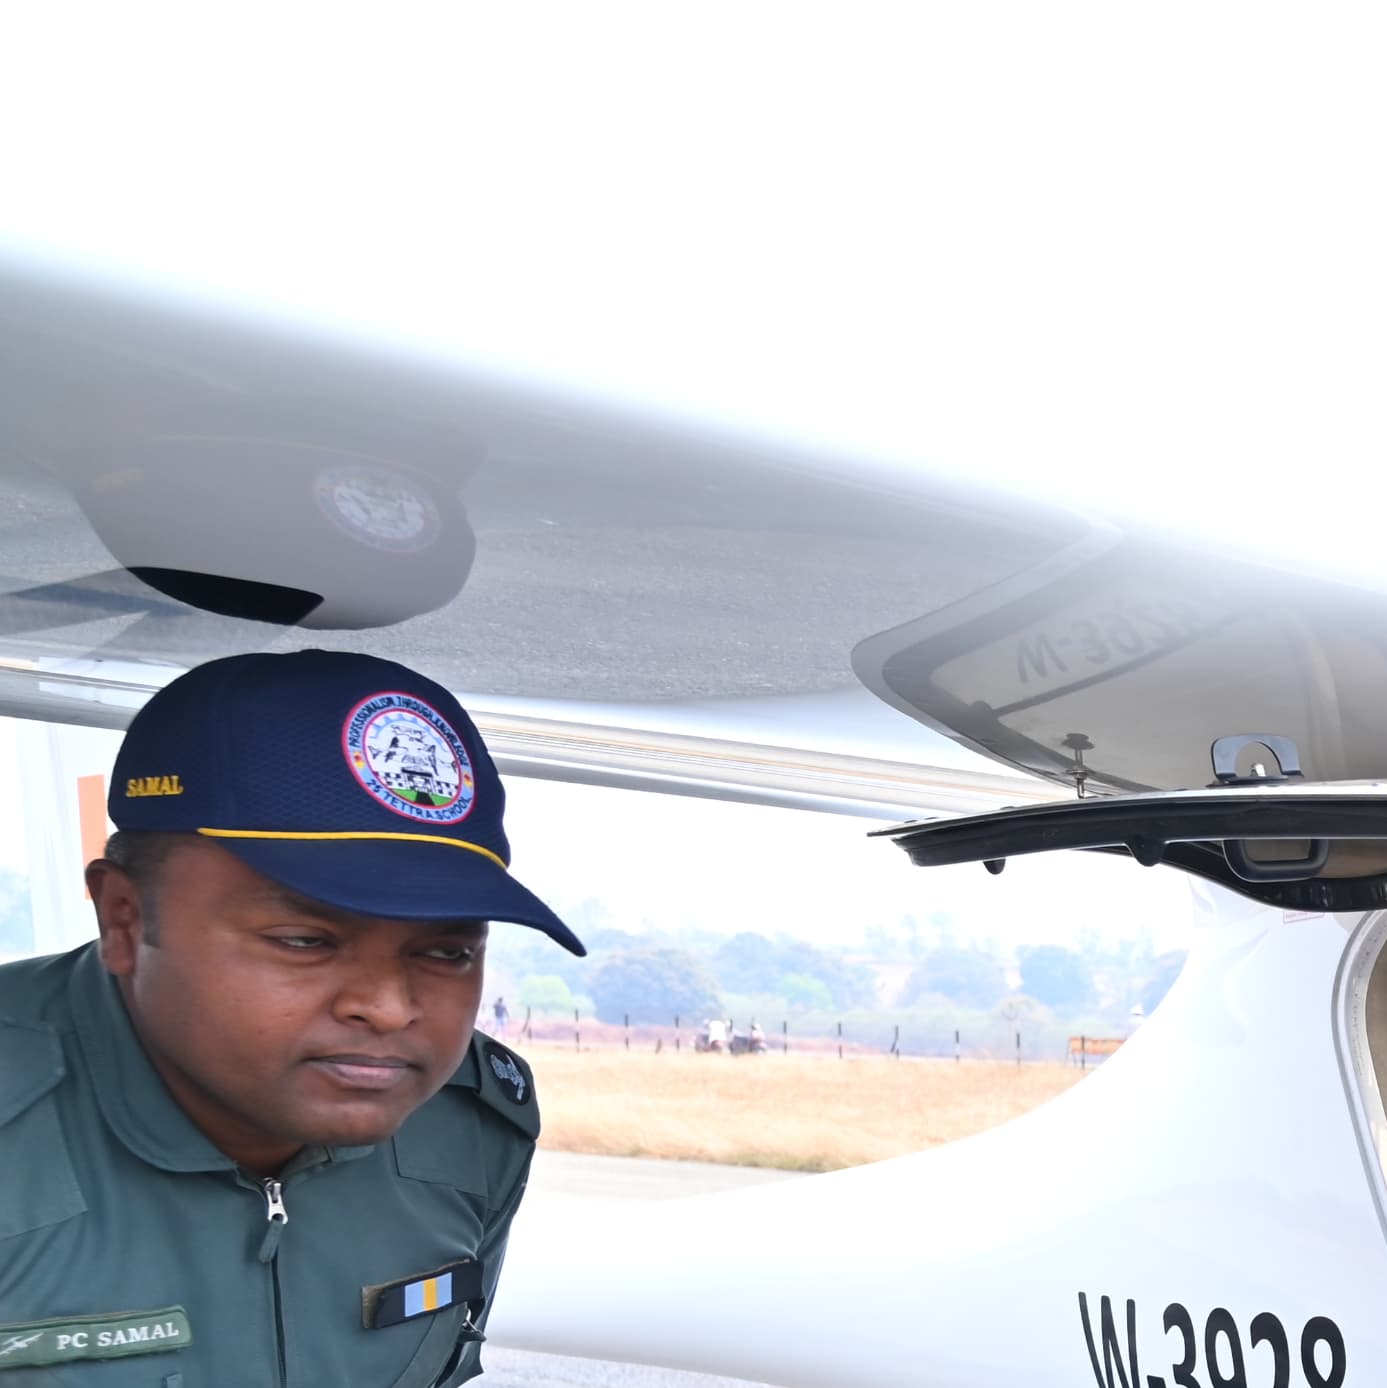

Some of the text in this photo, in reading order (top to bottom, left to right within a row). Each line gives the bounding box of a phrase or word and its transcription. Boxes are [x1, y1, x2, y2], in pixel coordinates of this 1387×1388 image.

[125, 775, 184, 797] SAMAL
[434, 797, 473, 820] SCHOOL
[56, 1322, 180, 1350] PC SAMAL
